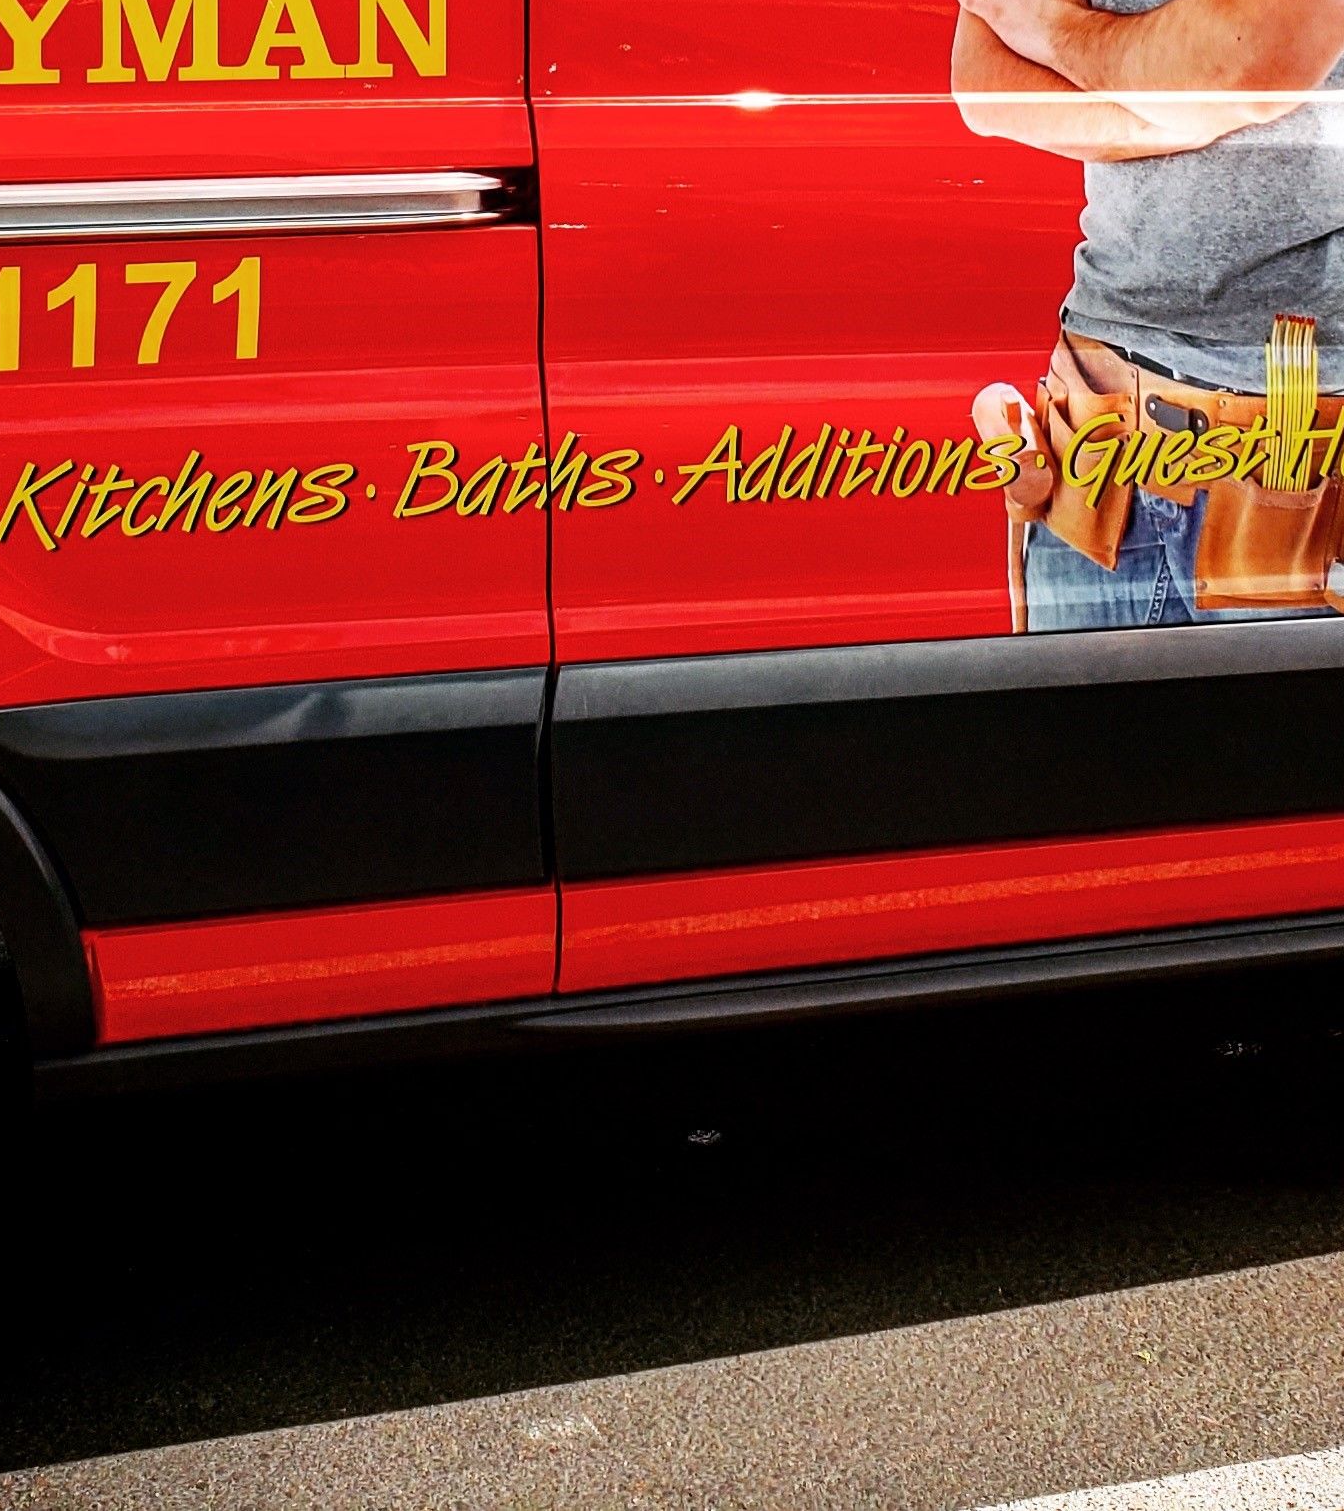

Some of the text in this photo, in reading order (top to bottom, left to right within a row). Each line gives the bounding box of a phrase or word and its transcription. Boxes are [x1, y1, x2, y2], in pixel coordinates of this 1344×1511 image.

[392, 430, 643, 521] Baths
[670, 422, 1027, 506] Additions
[1062, 412, 1278, 509] Guest
